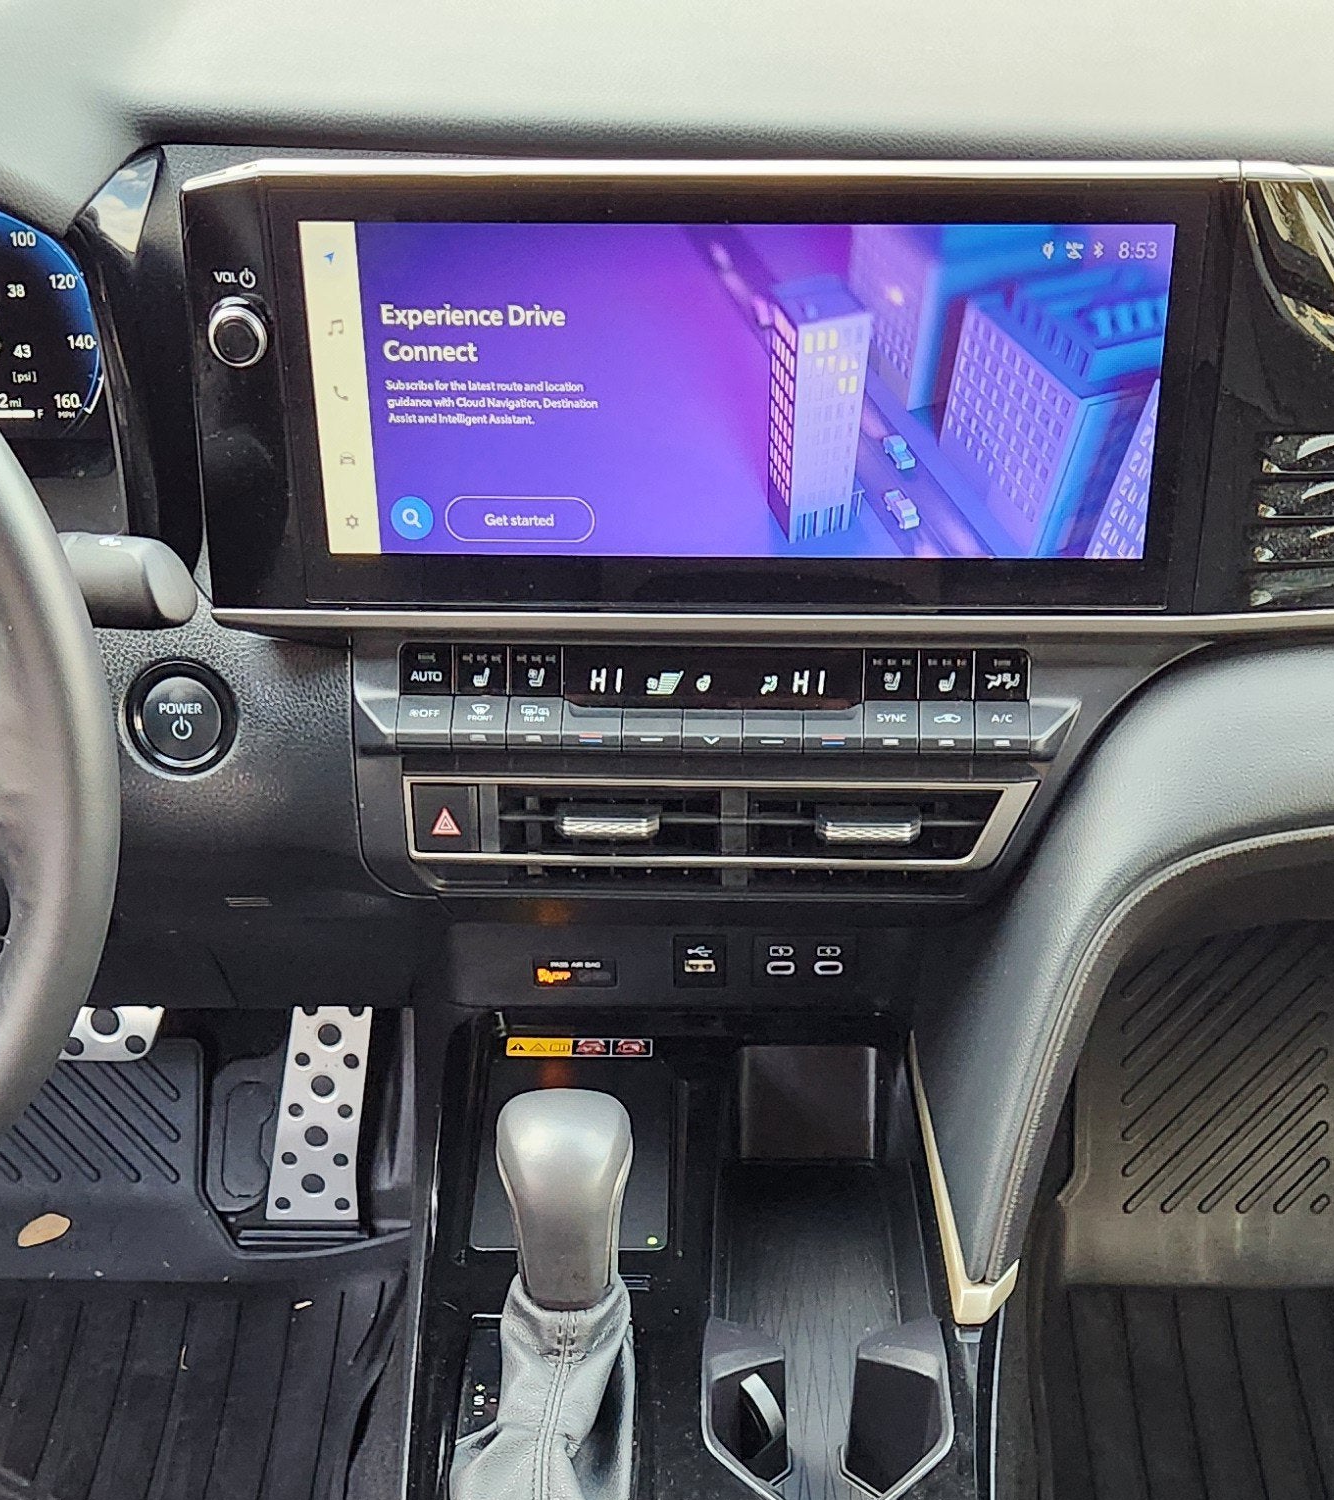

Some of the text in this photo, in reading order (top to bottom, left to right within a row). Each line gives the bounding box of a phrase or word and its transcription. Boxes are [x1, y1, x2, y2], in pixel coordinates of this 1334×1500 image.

[10, 231, 37, 247] 100
[1118, 241, 1158, 260] 8:53
[49, 274, 76, 290] 120
[213, 271, 238, 283] VOL
[7, 284, 25, 298] 38
[380, 303, 566, 330] Experience Drive
[67, 335, 93, 349] 140
[13, 345, 31, 358] 43
[383, 340, 478, 362] Connect
[385, 380, 584, 392] Subscribe for the latest route and location
[53, 394, 79, 408] 160
[387, 396, 599, 410] guidance with Cloud Navigation, Destination
[37, 409, 44, 419] F
[388, 413, 535, 427] Assist and Intelligent Assistant.
[484, 513, 555, 528] Get started
[410, 671, 443, 682] AUTO
[792, 670, 826, 695] HI
[158, 702, 203, 714] POWER
[420, 709, 441, 718] OFF
[876, 713, 908, 723] SYNC
[991, 713, 1013, 723] A/C
[473, 1395, 485, 1406] S
